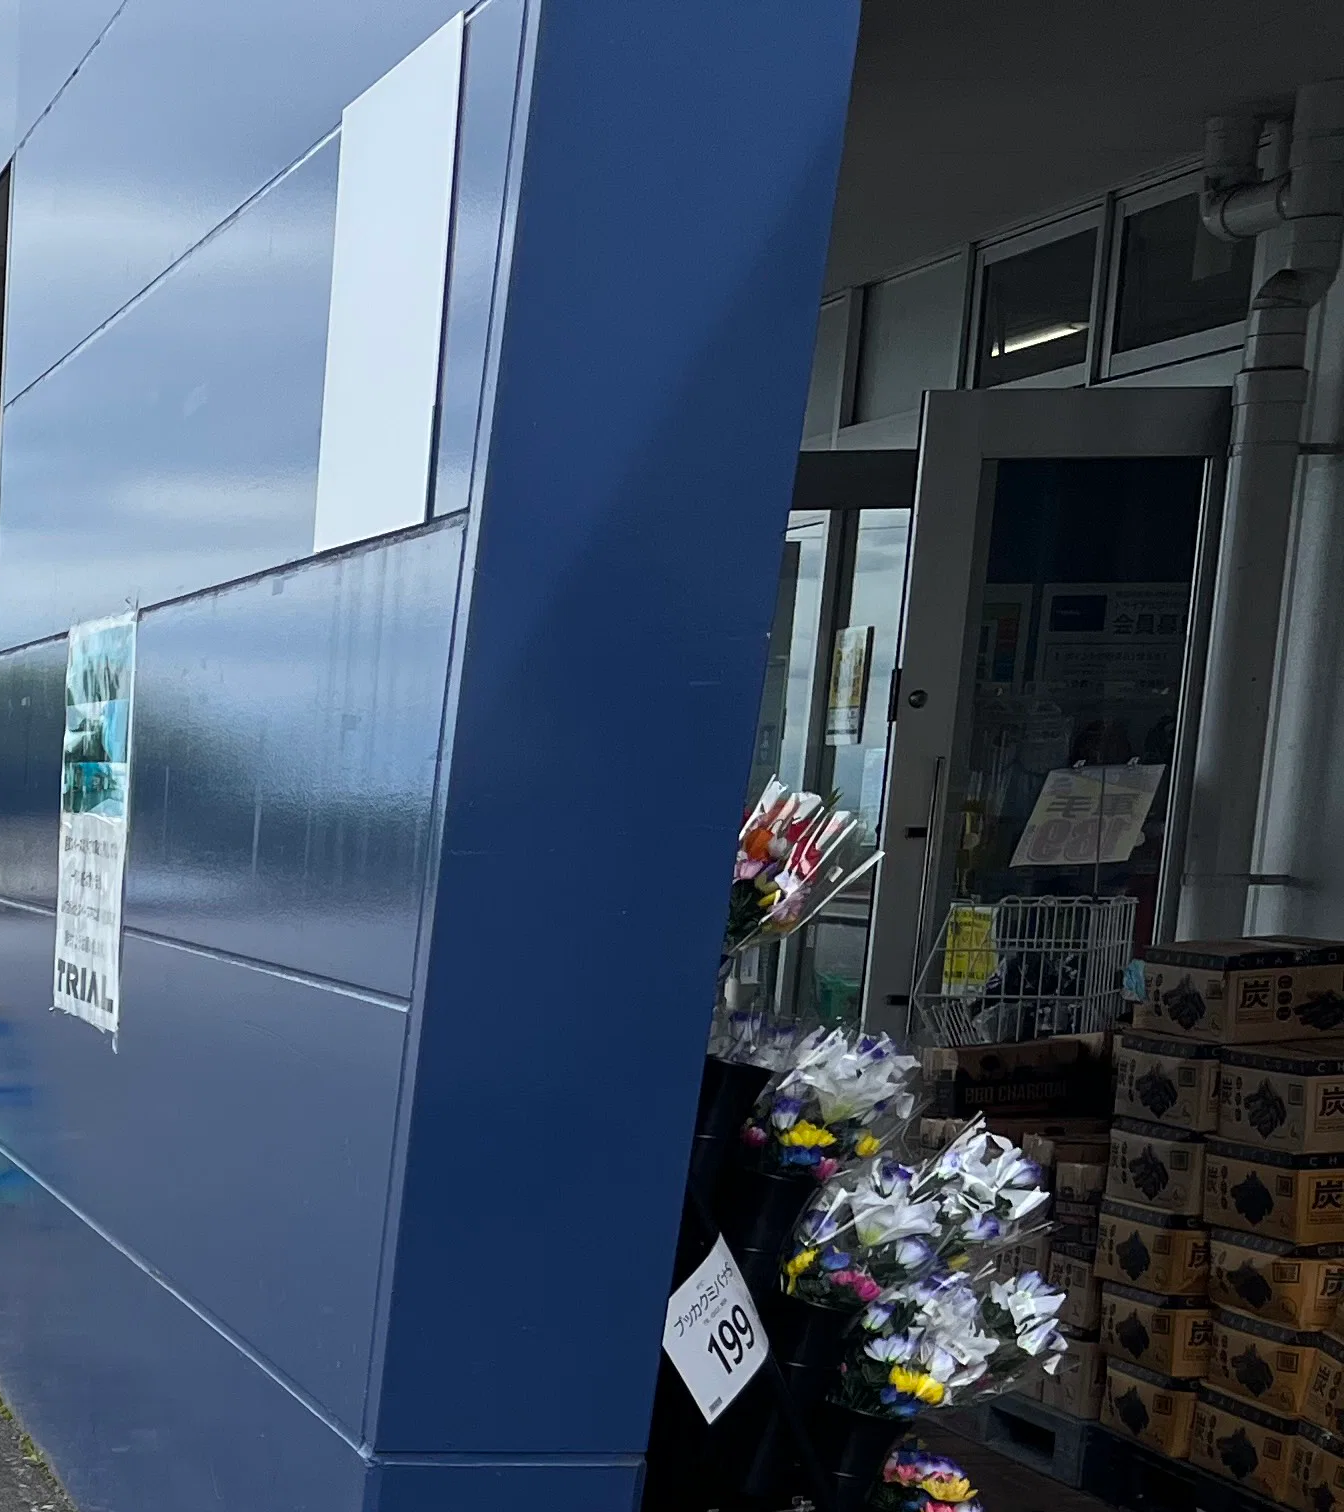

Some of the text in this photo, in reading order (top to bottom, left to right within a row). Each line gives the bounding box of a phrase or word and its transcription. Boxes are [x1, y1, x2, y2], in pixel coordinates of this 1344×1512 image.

[57, 958, 113, 1014] TRIAL
[1240, 980, 1270, 1009] 炭
[1312, 1180, 1343, 1210] 炭
[707, 1304, 755, 1375] 199
